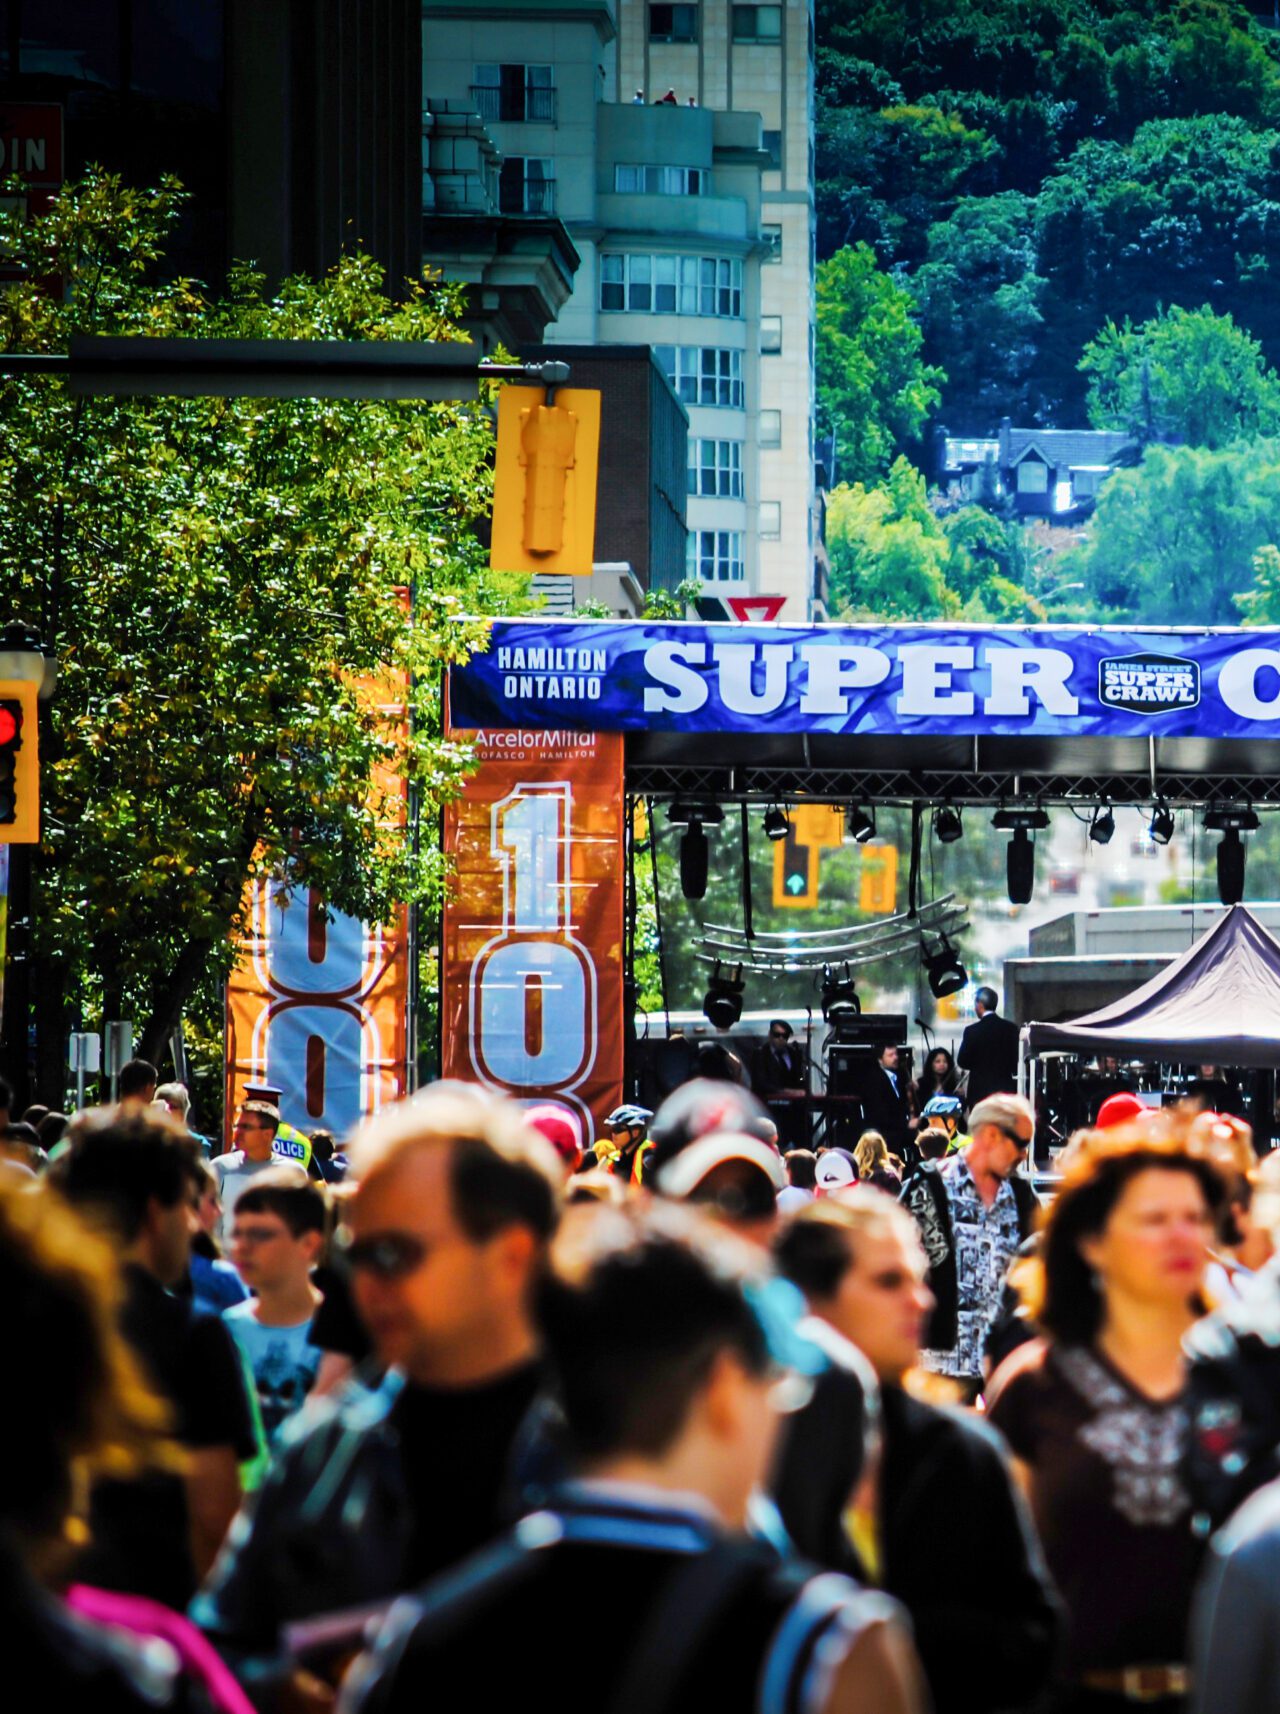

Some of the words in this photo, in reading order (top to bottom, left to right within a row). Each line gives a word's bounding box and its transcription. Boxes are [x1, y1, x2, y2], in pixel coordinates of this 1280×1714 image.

[498, 647, 606, 671] HAMILTON
[643, 640, 1079, 716] SUPER
[1105, 670, 1194, 688] SUPER
[504, 676, 601, 699] ONTARIO
[1105, 685, 1195, 702] CRAWL
[475, 729, 595, 748] ArcelorMittal
[540, 750, 596, 760] HAMILTON
[272, 1140, 304, 1158] OLICE
